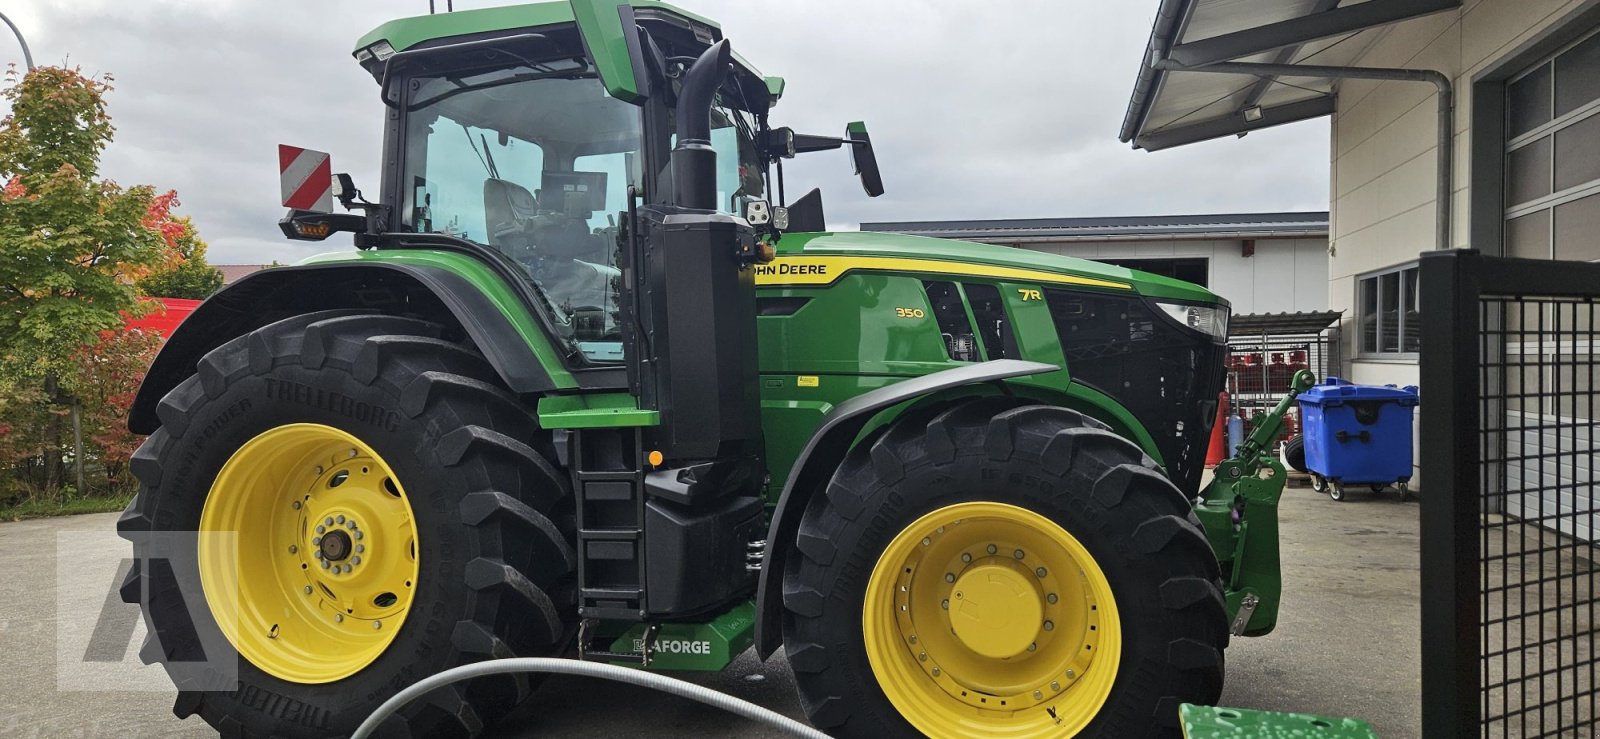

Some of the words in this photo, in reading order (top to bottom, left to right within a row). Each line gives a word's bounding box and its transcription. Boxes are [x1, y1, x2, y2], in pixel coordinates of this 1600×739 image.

[755, 264, 776, 275] HN
[779, 263, 827, 275] DEERE
[1017, 288, 1042, 302] 7R
[895, 307, 925, 319] 350
[264, 377, 401, 433] TRELLEBORG
[830, 490, 906, 601] TRELLEBORG
[652, 640, 711, 655] AFORGE
